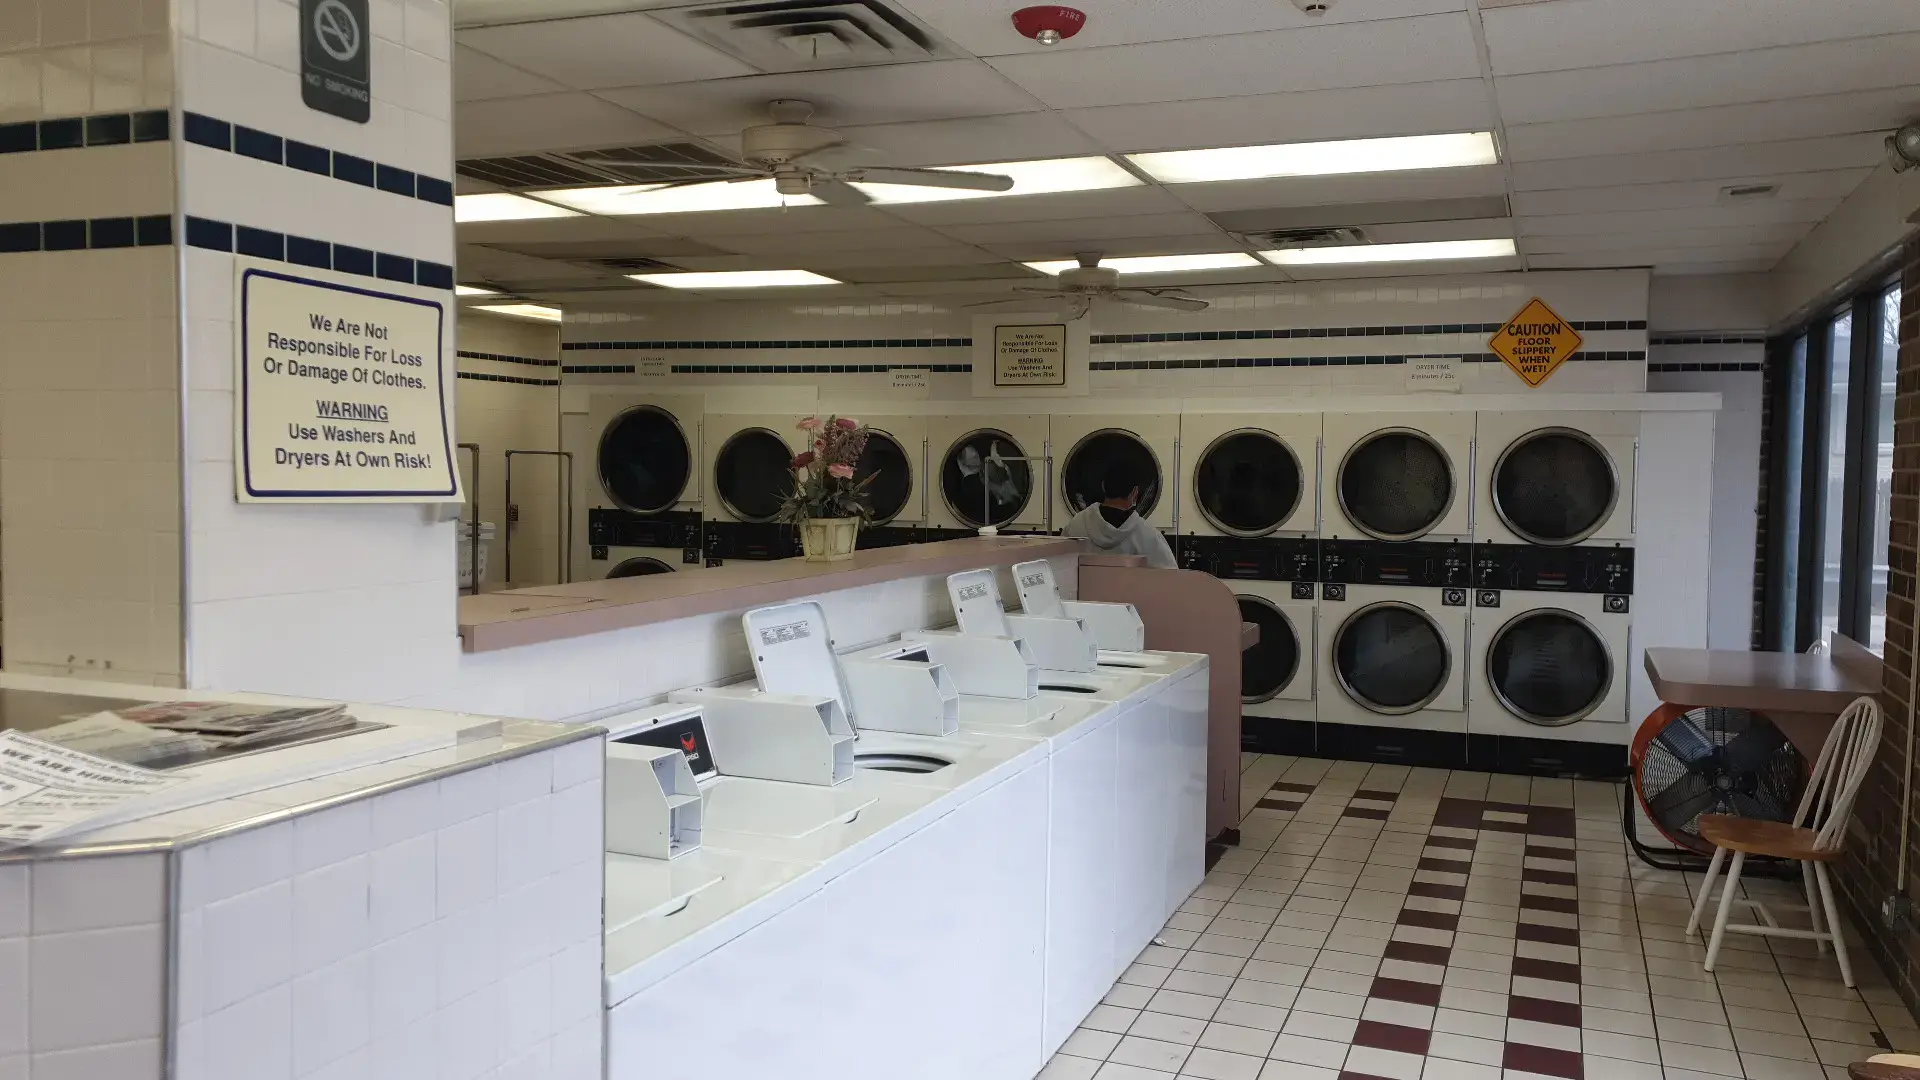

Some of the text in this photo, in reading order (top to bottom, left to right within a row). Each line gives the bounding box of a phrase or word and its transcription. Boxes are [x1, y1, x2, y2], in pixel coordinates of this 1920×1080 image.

[1059, 9, 1080, 22] FIRE
[304, 71, 368, 102] NO SMOKING
[309, 313, 388, 340] We Are Not
[1508, 323, 1561, 336] CAUTION
[268, 332, 422, 367] Responsible For Loss
[1512, 346, 1556, 355] SLIPPERY
[1518, 338, 1550, 346] FLOOR
[1518, 356, 1550, 364] WHEN
[1522, 365, 1547, 373] WET!
[263, 357, 426, 390] Or Damage Of Clothes.
[316, 400, 389, 421] WARNING
[289, 423, 416, 445] Use Washers And
[275, 448, 432, 469] Dryers At Own Risk!
[2, 748, 34, 761] WE
[34, 759, 76, 773] ARE
